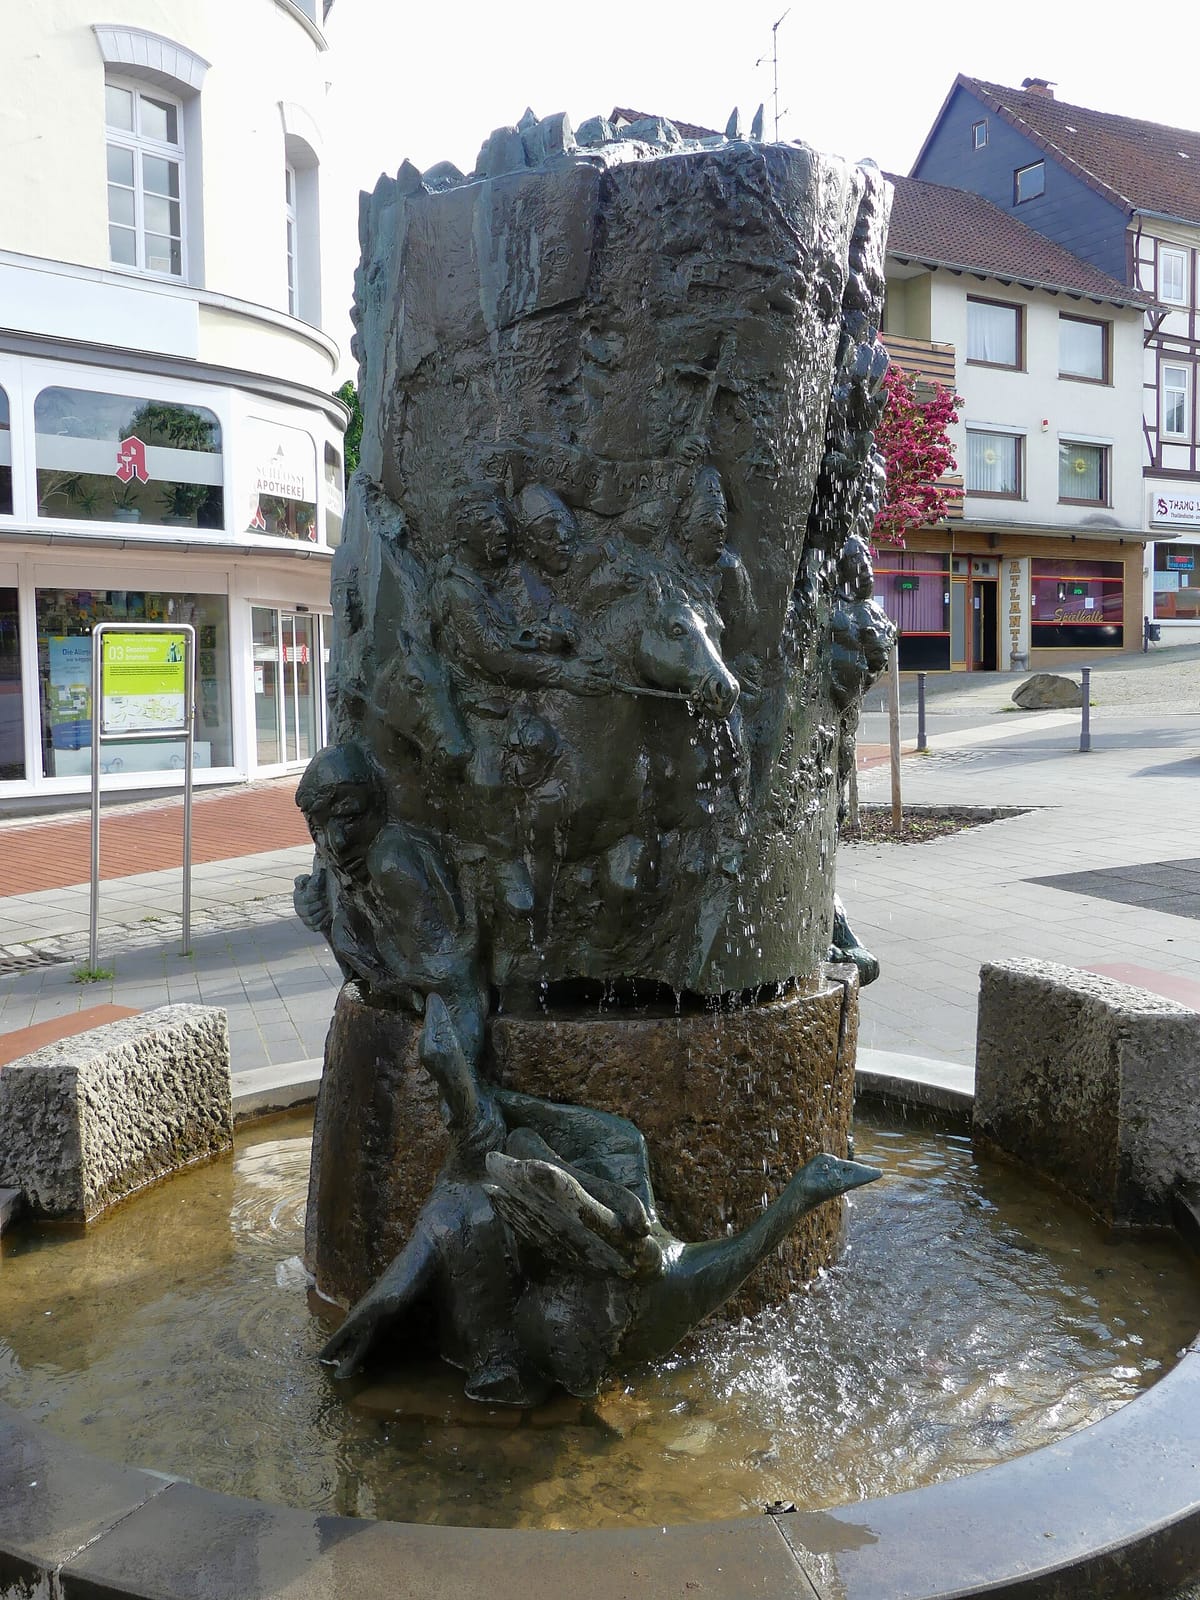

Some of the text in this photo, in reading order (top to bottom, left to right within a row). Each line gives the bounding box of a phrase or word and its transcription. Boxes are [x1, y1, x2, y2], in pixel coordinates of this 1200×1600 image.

[257, 479, 301, 497] APOTHEKE
[1009, 561, 1021, 663] ATLANTI
[1053, 608, 1104, 622] Spielhalle
[109, 646, 123, 660] 03
